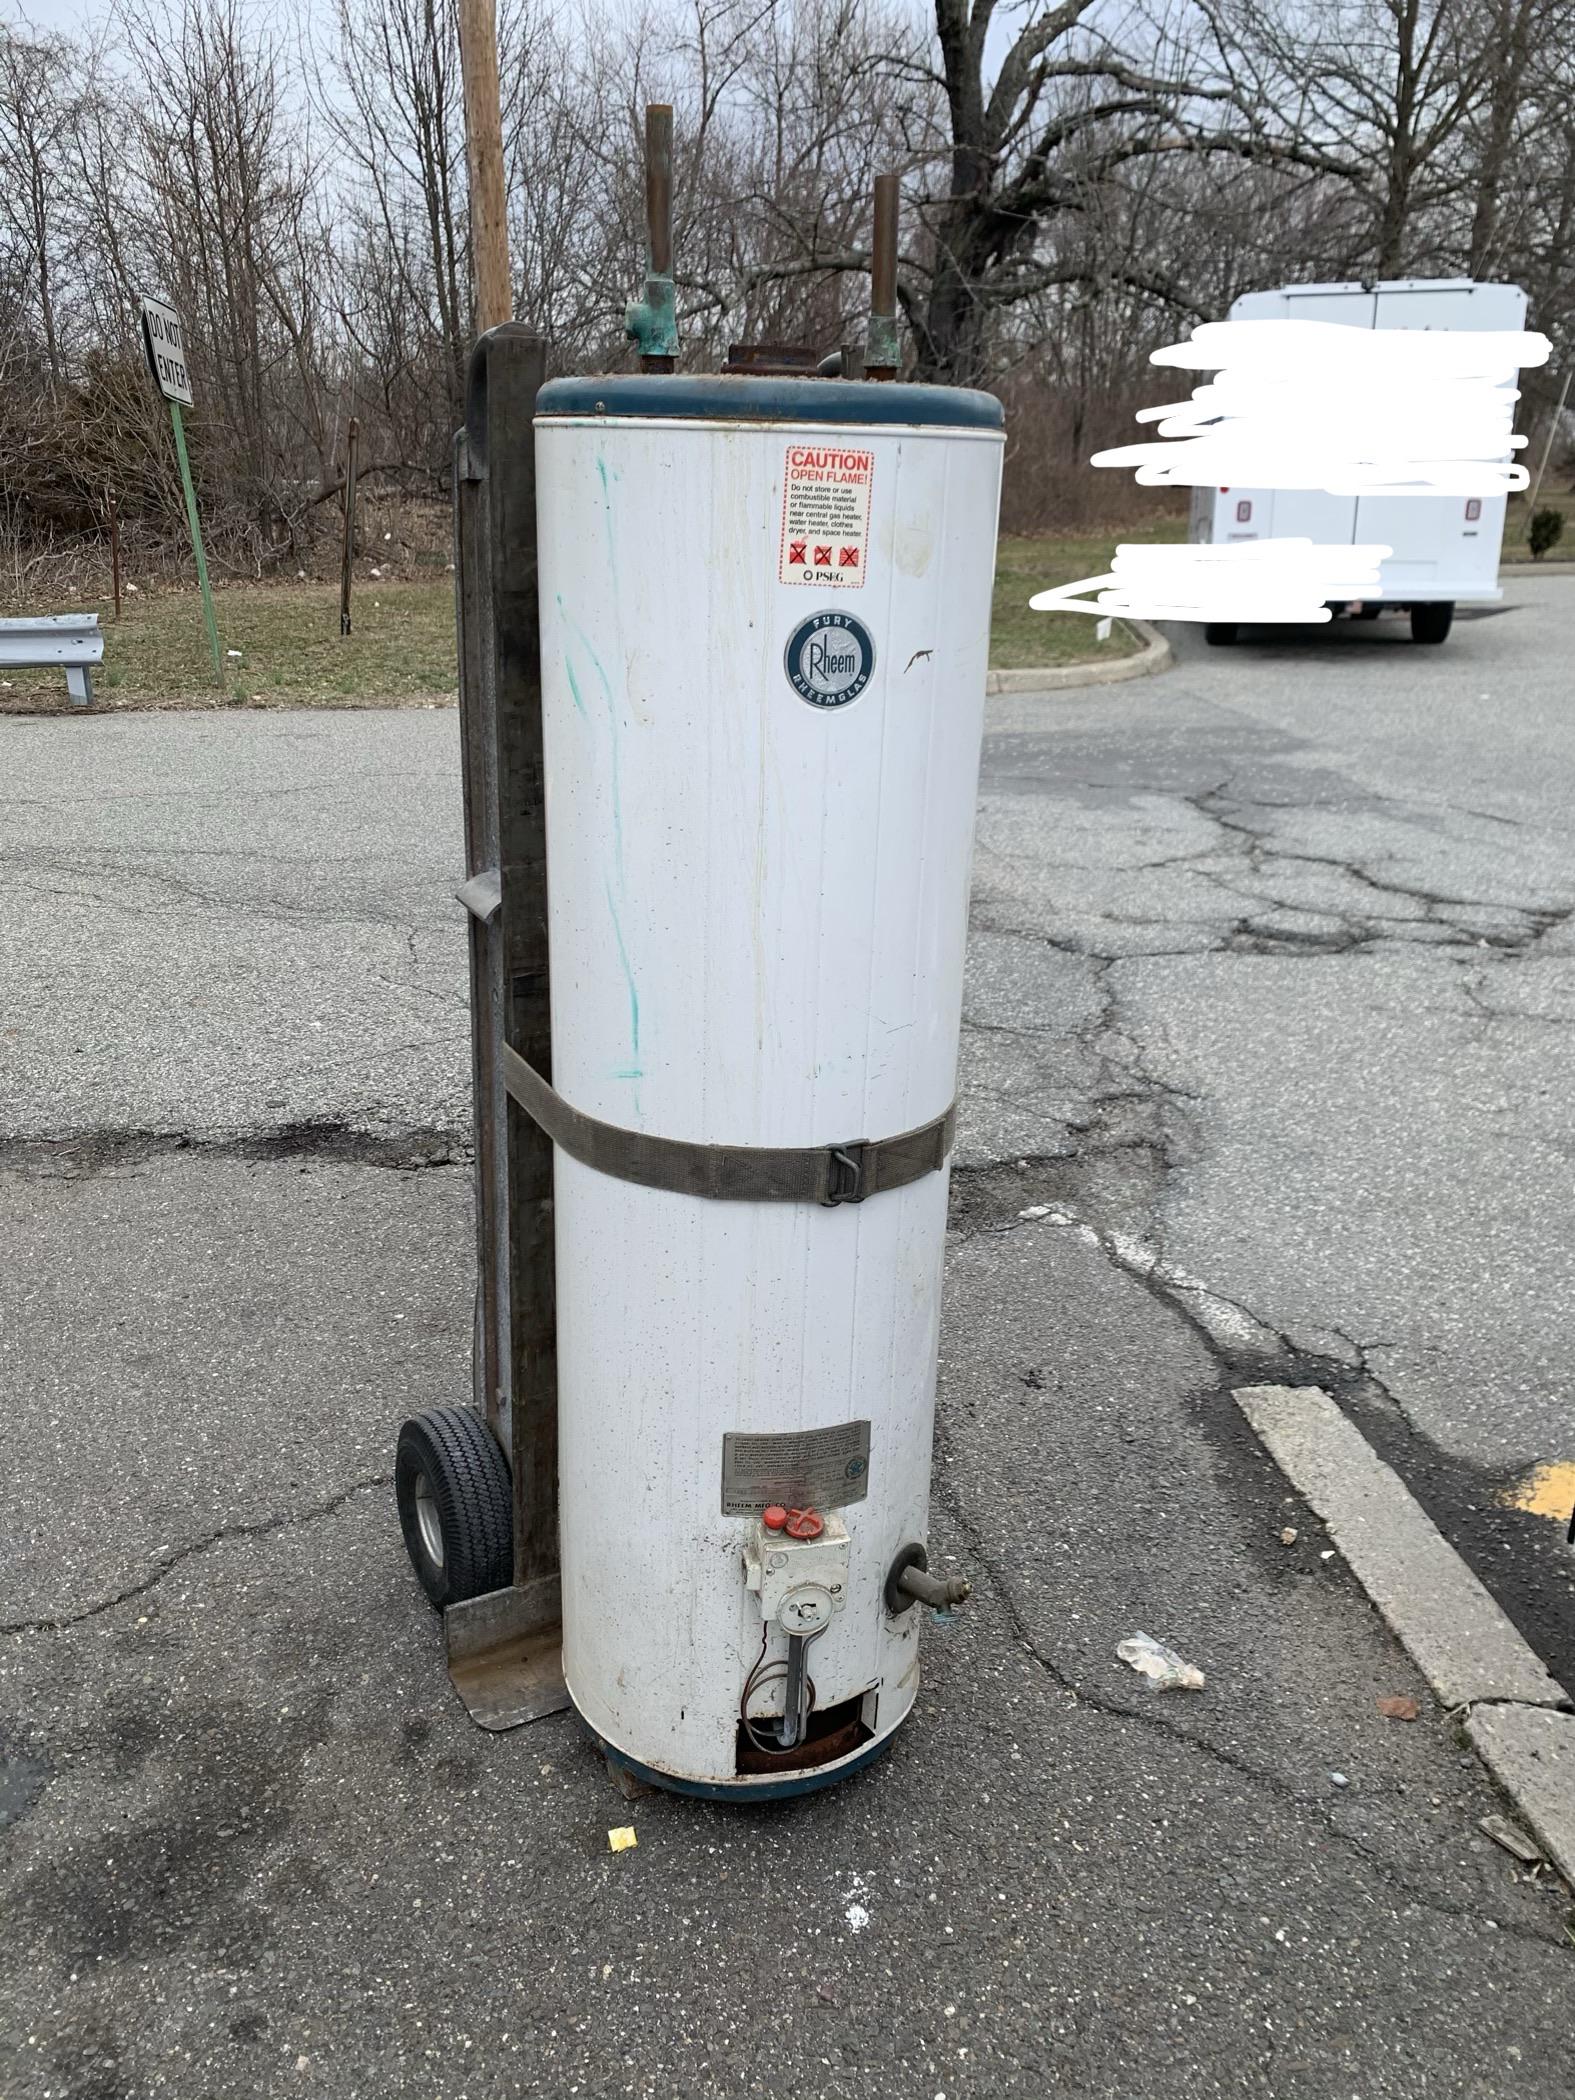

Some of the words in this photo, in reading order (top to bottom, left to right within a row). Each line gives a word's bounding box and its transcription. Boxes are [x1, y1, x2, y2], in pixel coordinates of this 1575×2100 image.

[149, 310, 163, 340] DO
[163, 318, 181, 350] NOT
[158, 354, 187, 390] ENTER
[791, 450, 869, 471] CAUTION
[790, 468, 823, 482] OPEN
[826, 471, 868, 485] FLAME!
[814, 485, 831, 493] store
[790, 493, 830, 501] combustible
[832, 495, 857, 503] material
[799, 502, 832, 510] flammable
[833, 504, 855, 513] liquids
[808, 519, 829, 528] heater,
[830, 520, 853, 528] clothes
[788, 527, 807, 536] dryer,
[822, 529, 841, 537] space
[816, 571, 844, 582] PSEG
[812, 616, 853, 629] FURY
[809, 634, 855, 681] Rheem
[792, 673, 867, 704] RHEEMGLAS
